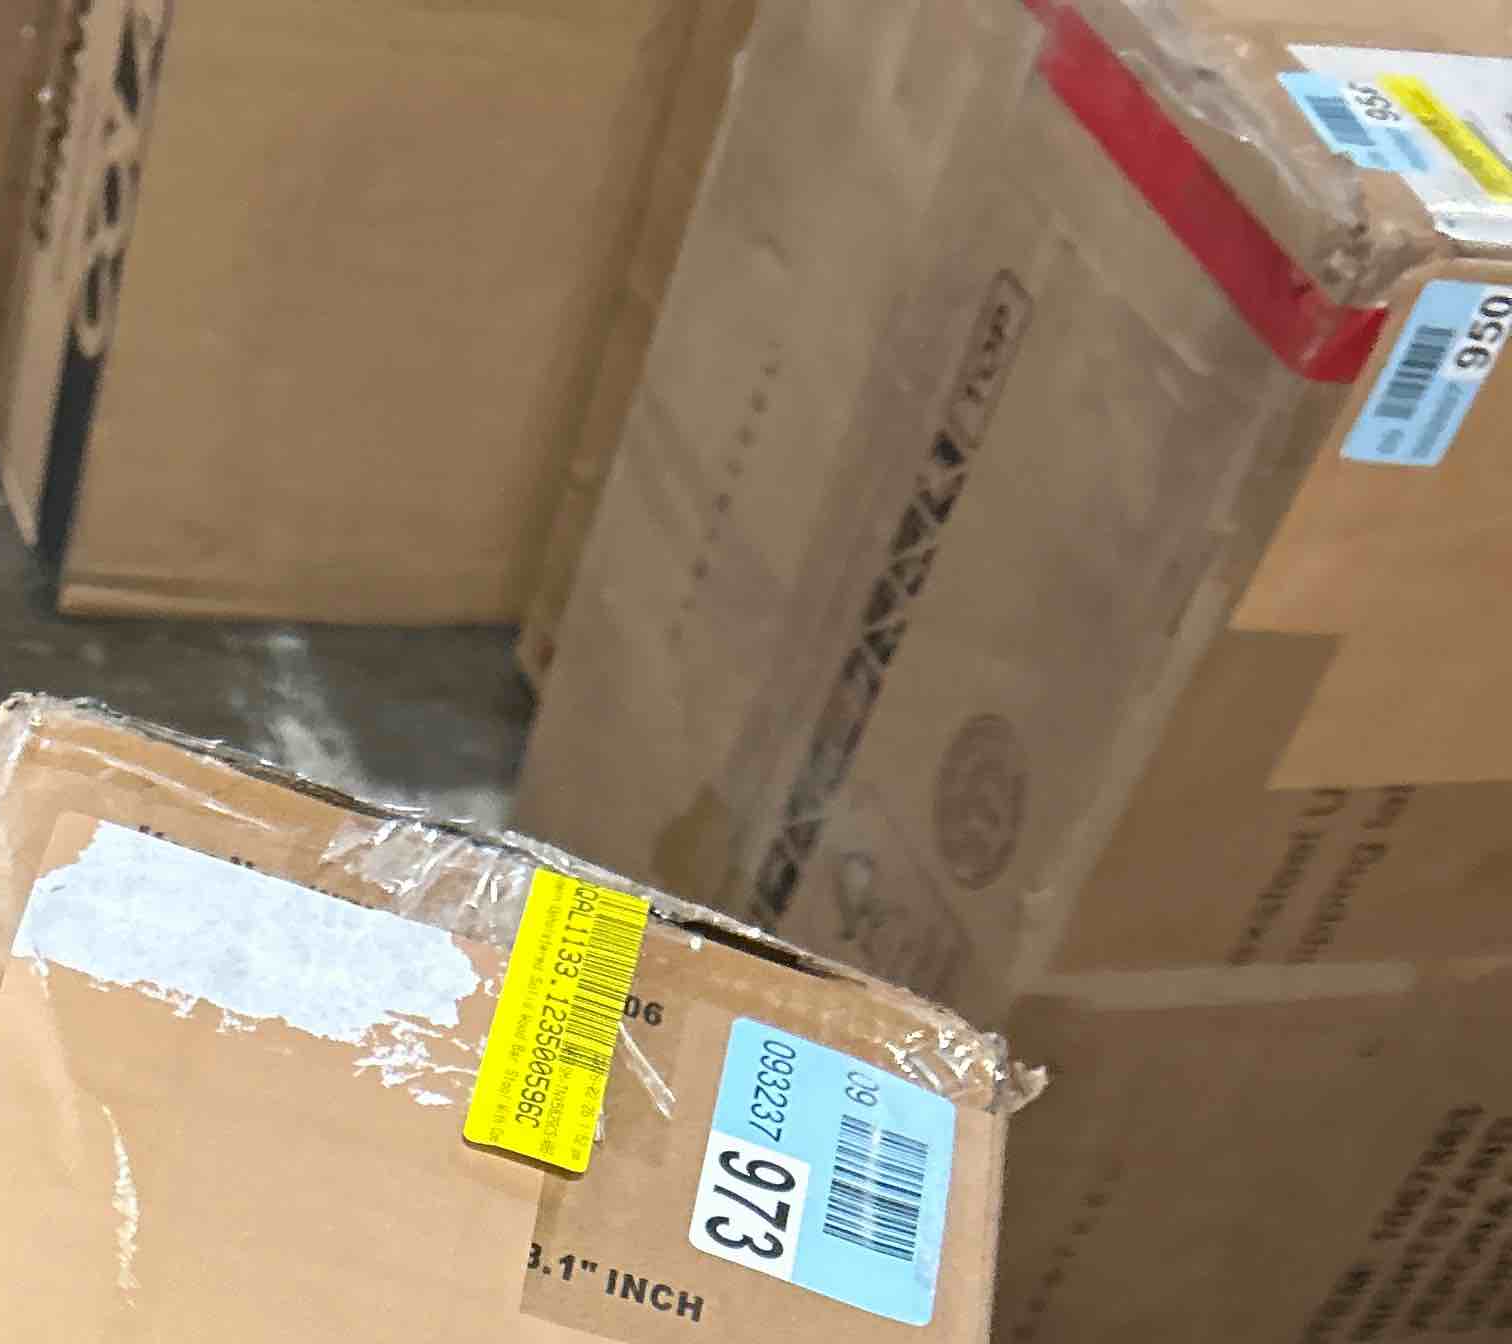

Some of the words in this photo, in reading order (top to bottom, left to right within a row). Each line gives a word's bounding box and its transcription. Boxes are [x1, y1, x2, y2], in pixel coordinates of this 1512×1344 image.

[1455, 295, 1512, 370] 950
[749, 1040, 796, 1142] 093237
[844, 1071, 880, 1107] 09
[705, 1151, 796, 1259] 973
[605, 1268, 704, 1322] INCH
